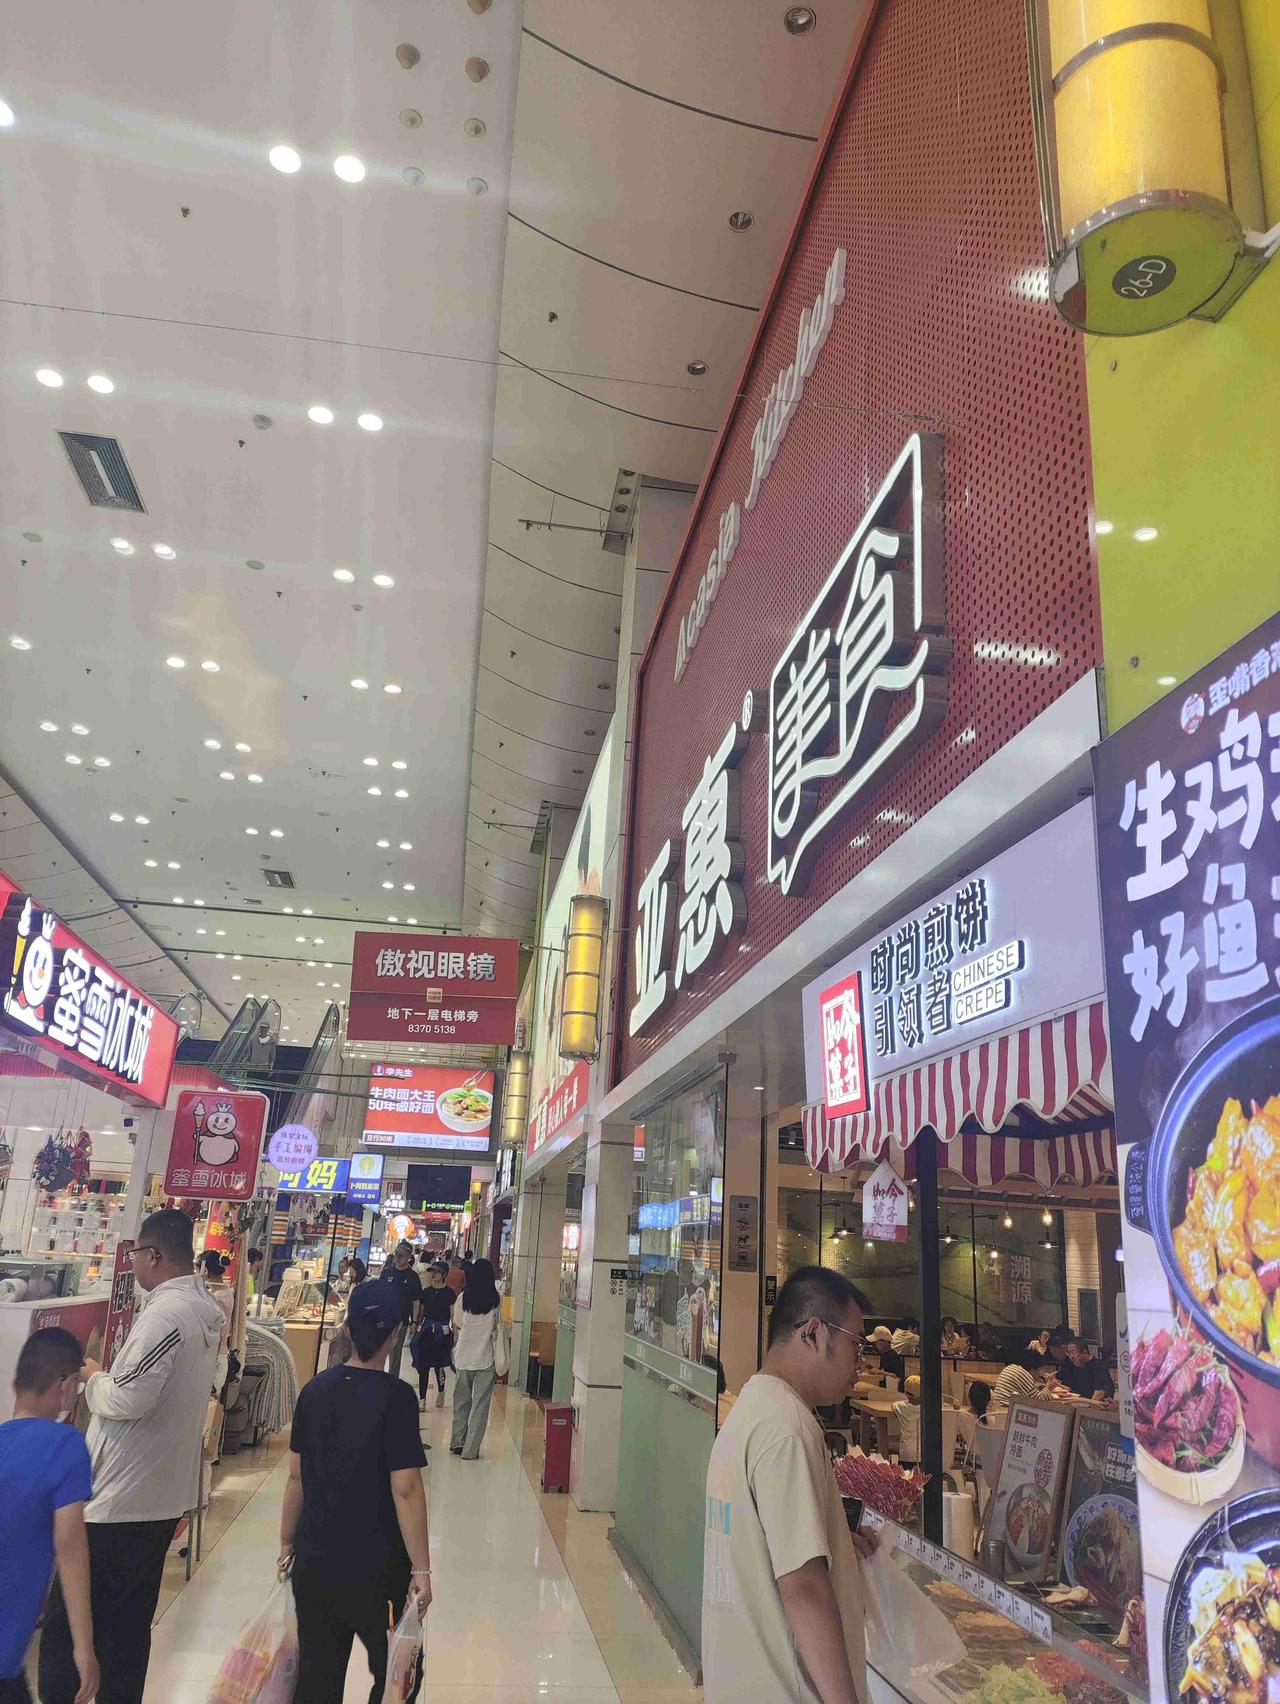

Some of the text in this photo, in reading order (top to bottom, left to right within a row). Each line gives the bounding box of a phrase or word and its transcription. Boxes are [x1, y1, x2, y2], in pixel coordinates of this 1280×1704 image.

[1121, 258, 1167, 298] 26-D
[629, 526, 930, 1037] 亚惠 美食
[1119, 708, 1280, 902] 生鸡
[870, 879, 989, 997] 时尚煎饼
[1123, 862, 1280, 1043] 好鱼
[375, 948, 496, 982] 傲视眼镜
[952, 945, 1017, 993] CHINESE
[48, 947, 155, 1085] 蜜雪冰城
[387, 1007, 479, 1023] 地下一层电梯旁
[873, 968, 953, 1058] 引领者
[954, 985, 1005, 1020] CREPE
[407, 1024, 456, 1035] 8370 5138
[368, 1098, 436, 1115] 50年做好面
[369, 1086, 436, 1102] 牛肉面大王
[170, 1167, 248, 1191] 蜜雪冰城
[1010, 1255, 1033, 1305] 溯源
